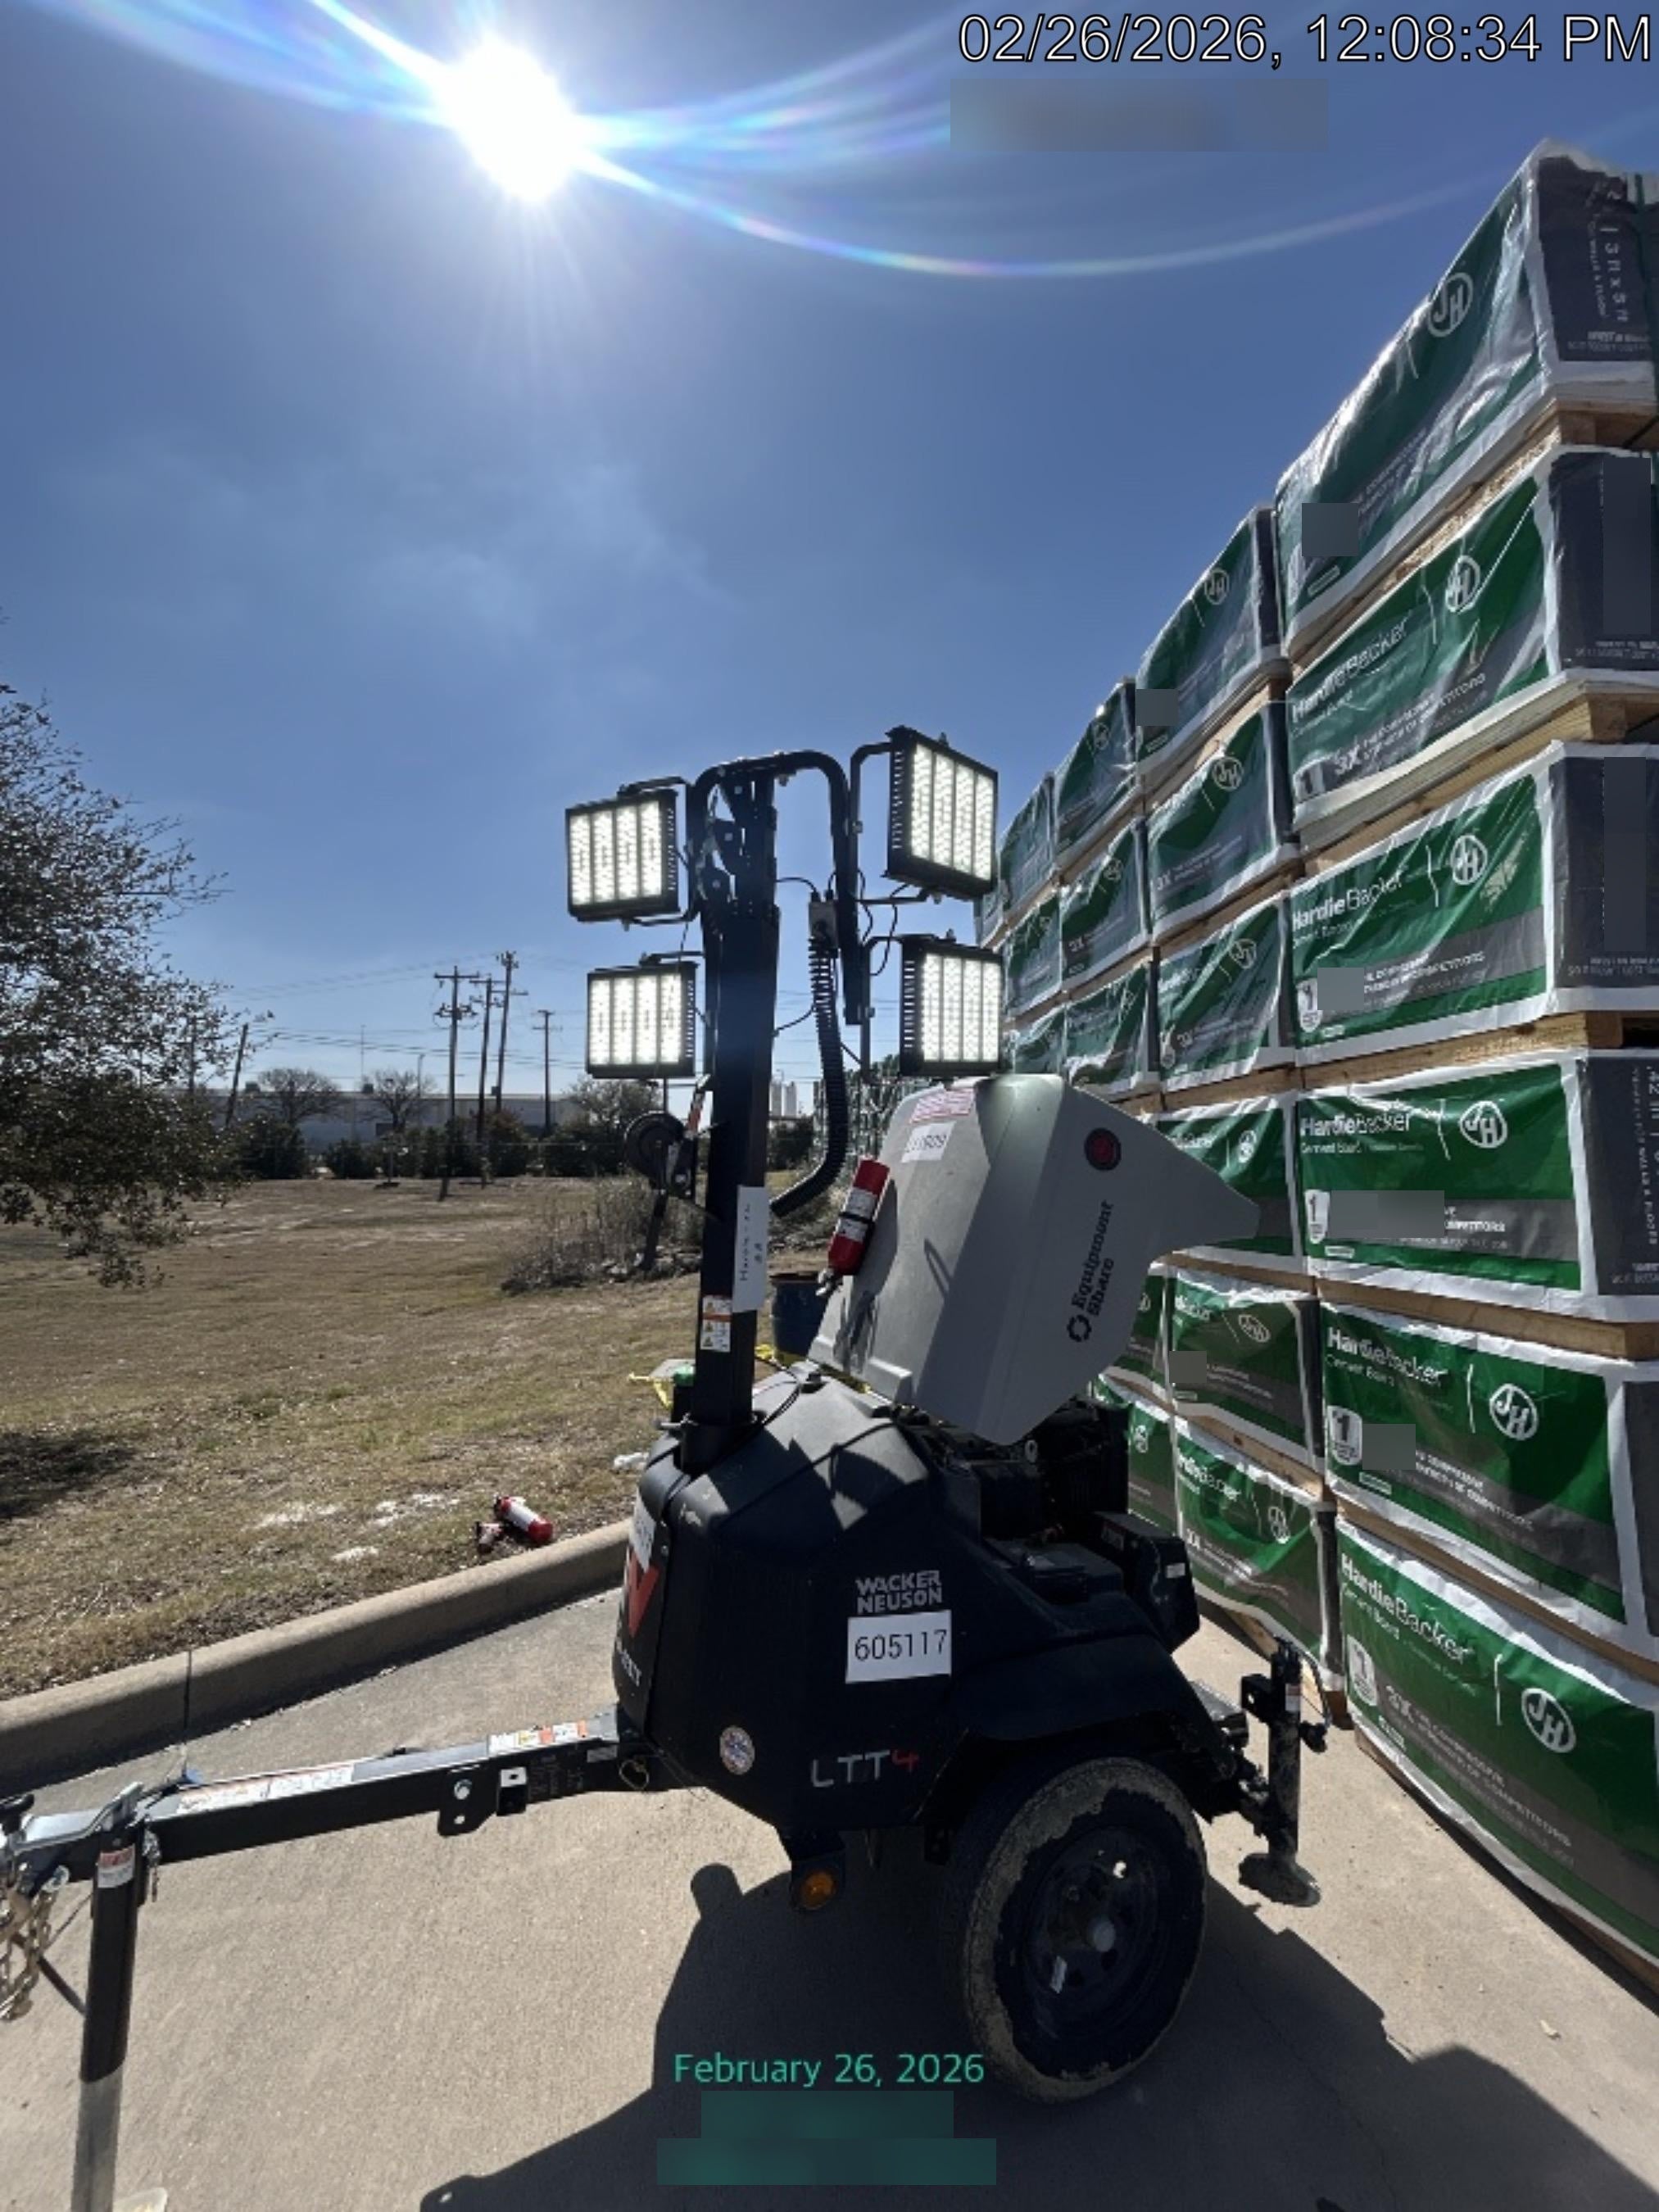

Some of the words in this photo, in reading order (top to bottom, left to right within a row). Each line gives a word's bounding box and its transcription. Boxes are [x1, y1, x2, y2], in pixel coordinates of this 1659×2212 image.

[1300, 1112, 1410, 1137] HardieBacker
[1462, 1103, 1503, 1146] JH
[1071, 1199, 1114, 1310] Equipment
[1086, 1258, 1114, 1317] Share
[1327, 1326, 1448, 1387] HardieBacker
[1492, 1387, 1534, 1438] JH
[856, 1570, 942, 1596] WACKER
[857, 1587, 943, 1615] NEUSON
[1341, 1552, 1474, 1665] HardieBacker
[854, 1629, 948, 1661] 605117
[1525, 1693, 1574, 1751] JH
